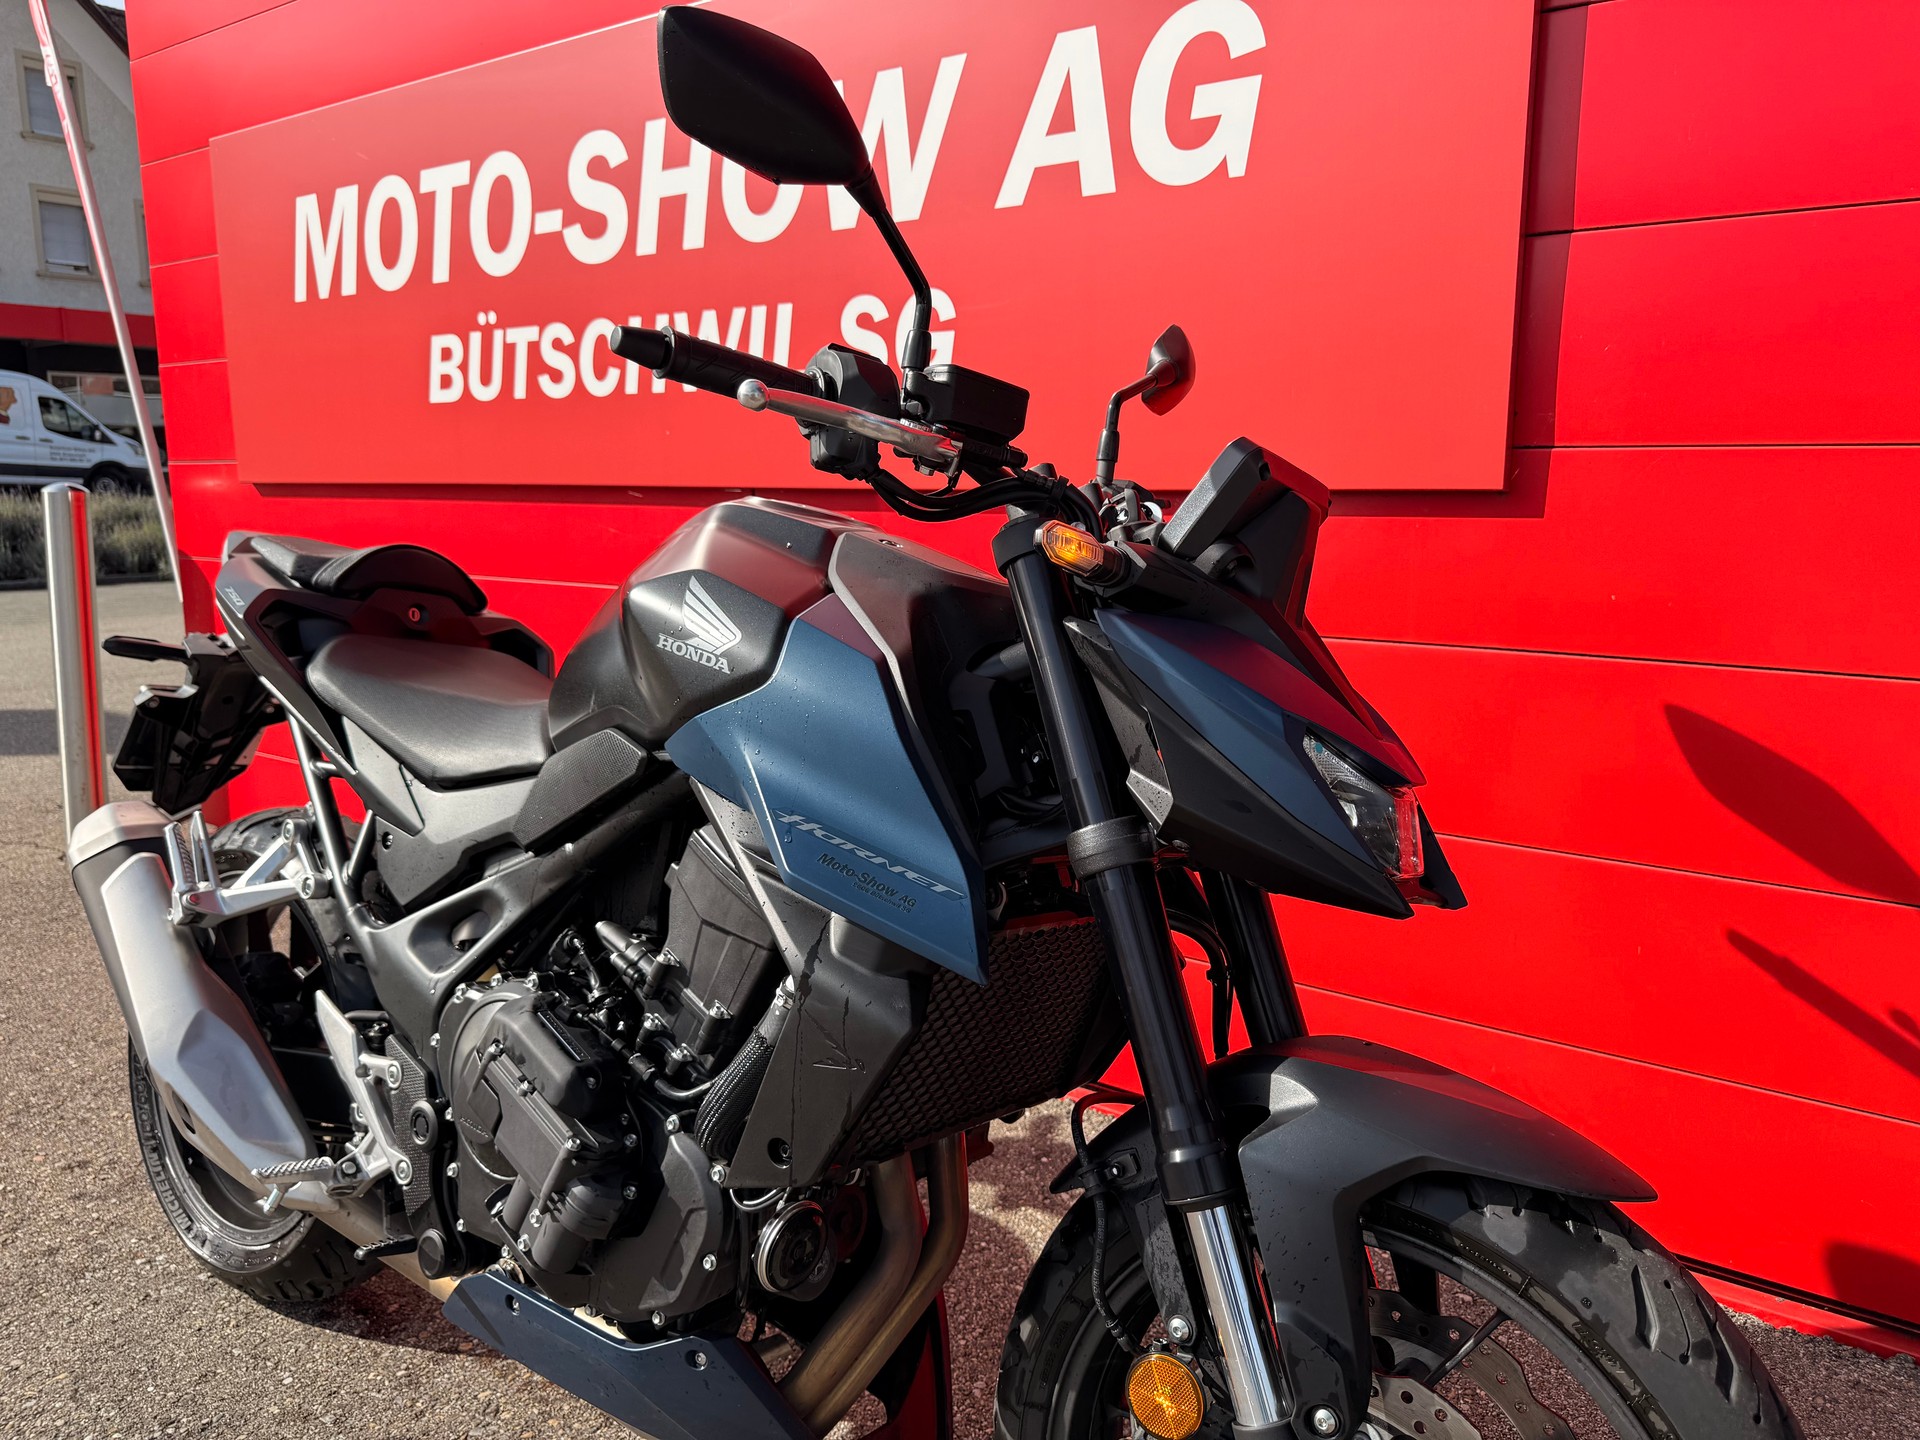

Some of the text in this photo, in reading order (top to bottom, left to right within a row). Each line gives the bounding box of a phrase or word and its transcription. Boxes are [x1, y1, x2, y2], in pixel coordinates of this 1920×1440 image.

[994, 0, 1266, 210] AG
[840, 287, 957, 372] SG
[657, 633, 731, 674] HONDA
[817, 853, 917, 908] Moto-Show AG
[147, 1151, 194, 1231] MICHELIN
